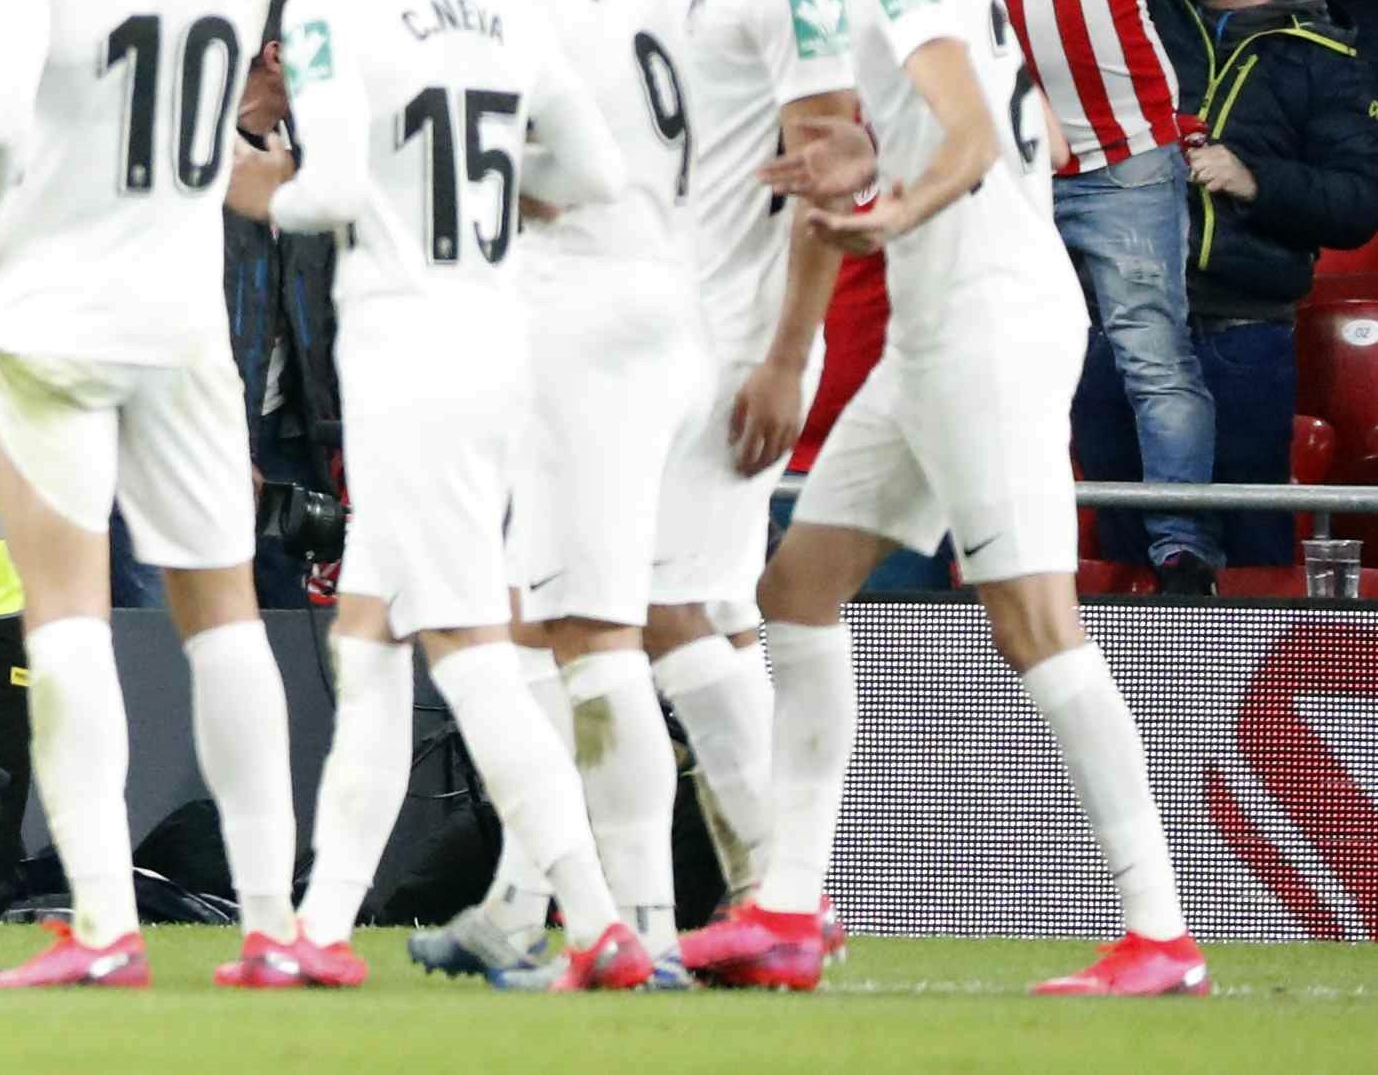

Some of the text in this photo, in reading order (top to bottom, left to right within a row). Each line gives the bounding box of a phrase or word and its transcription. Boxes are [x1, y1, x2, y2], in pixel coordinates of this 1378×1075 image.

[96, 14, 241, 199] 10
[394, 86, 524, 267] 15
[633, 30, 693, 207] 9
